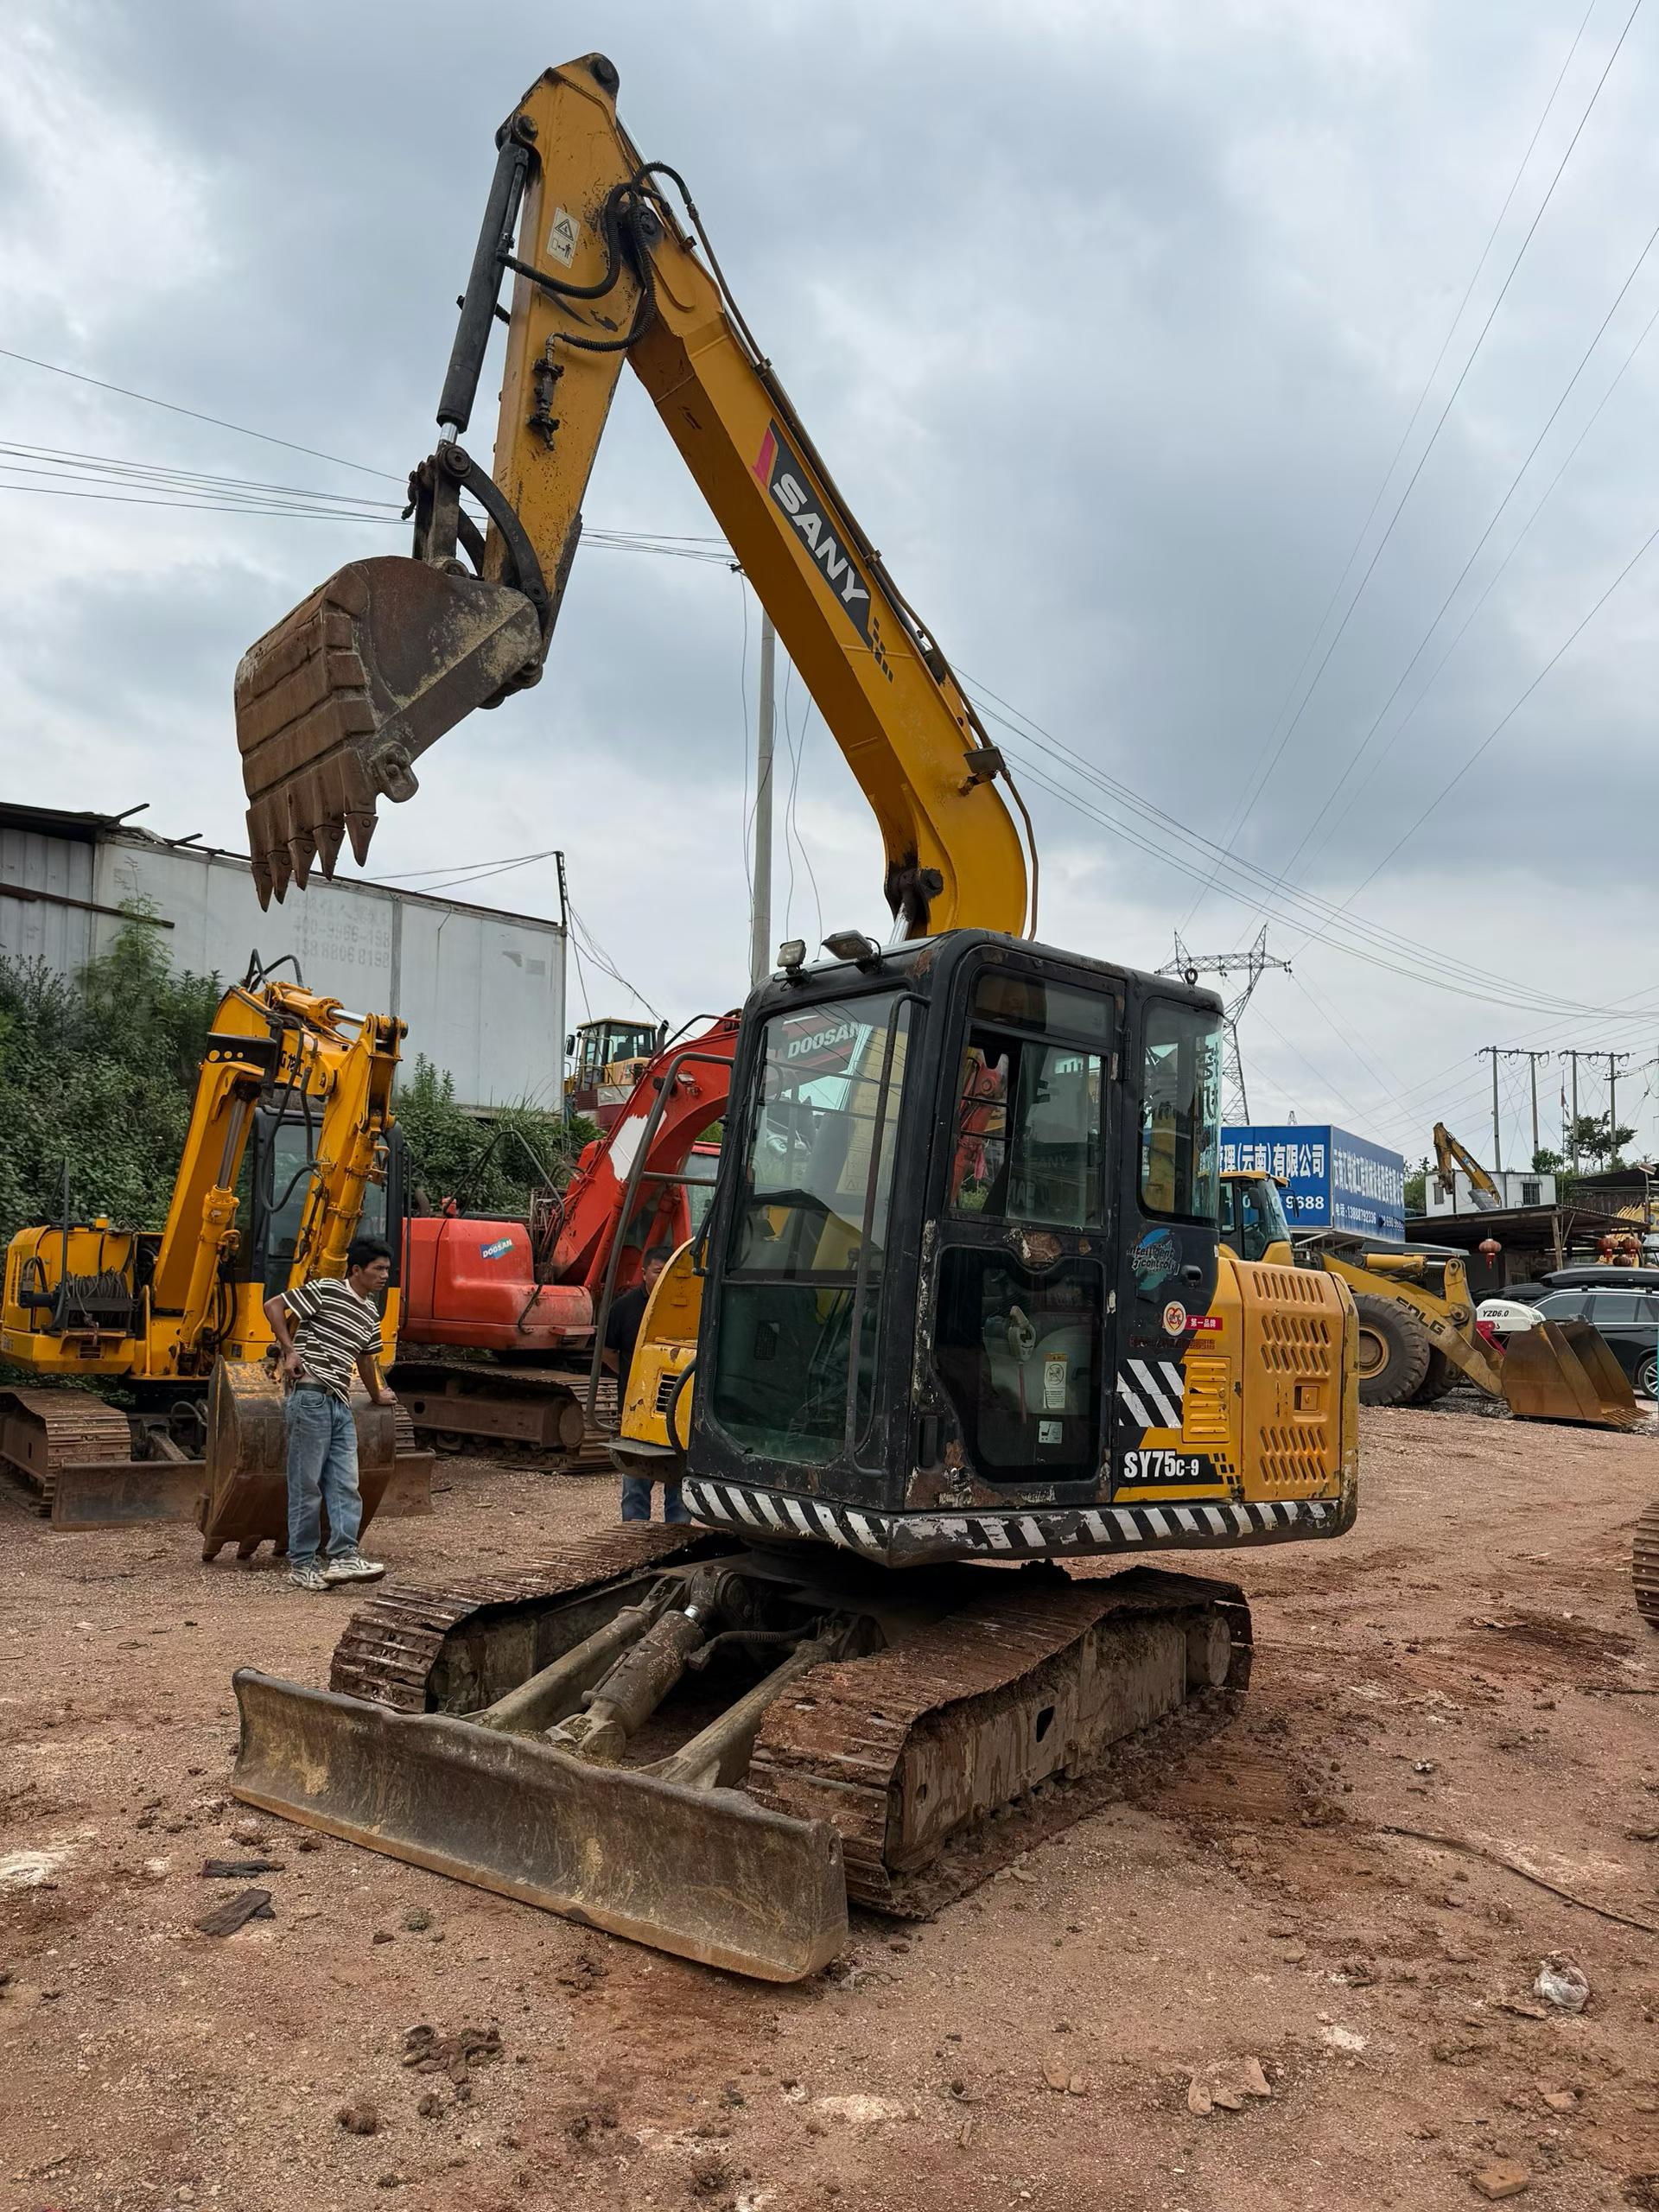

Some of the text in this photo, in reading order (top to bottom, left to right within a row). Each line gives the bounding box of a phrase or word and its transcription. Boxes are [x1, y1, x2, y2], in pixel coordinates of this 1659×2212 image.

[772, 474, 869, 603] SANY
[787, 1021, 861, 1058] DOOSAN
[483, 1238, 512, 1258] DOOSAN
[1124, 1451, 1199, 1478] SY75C-9
